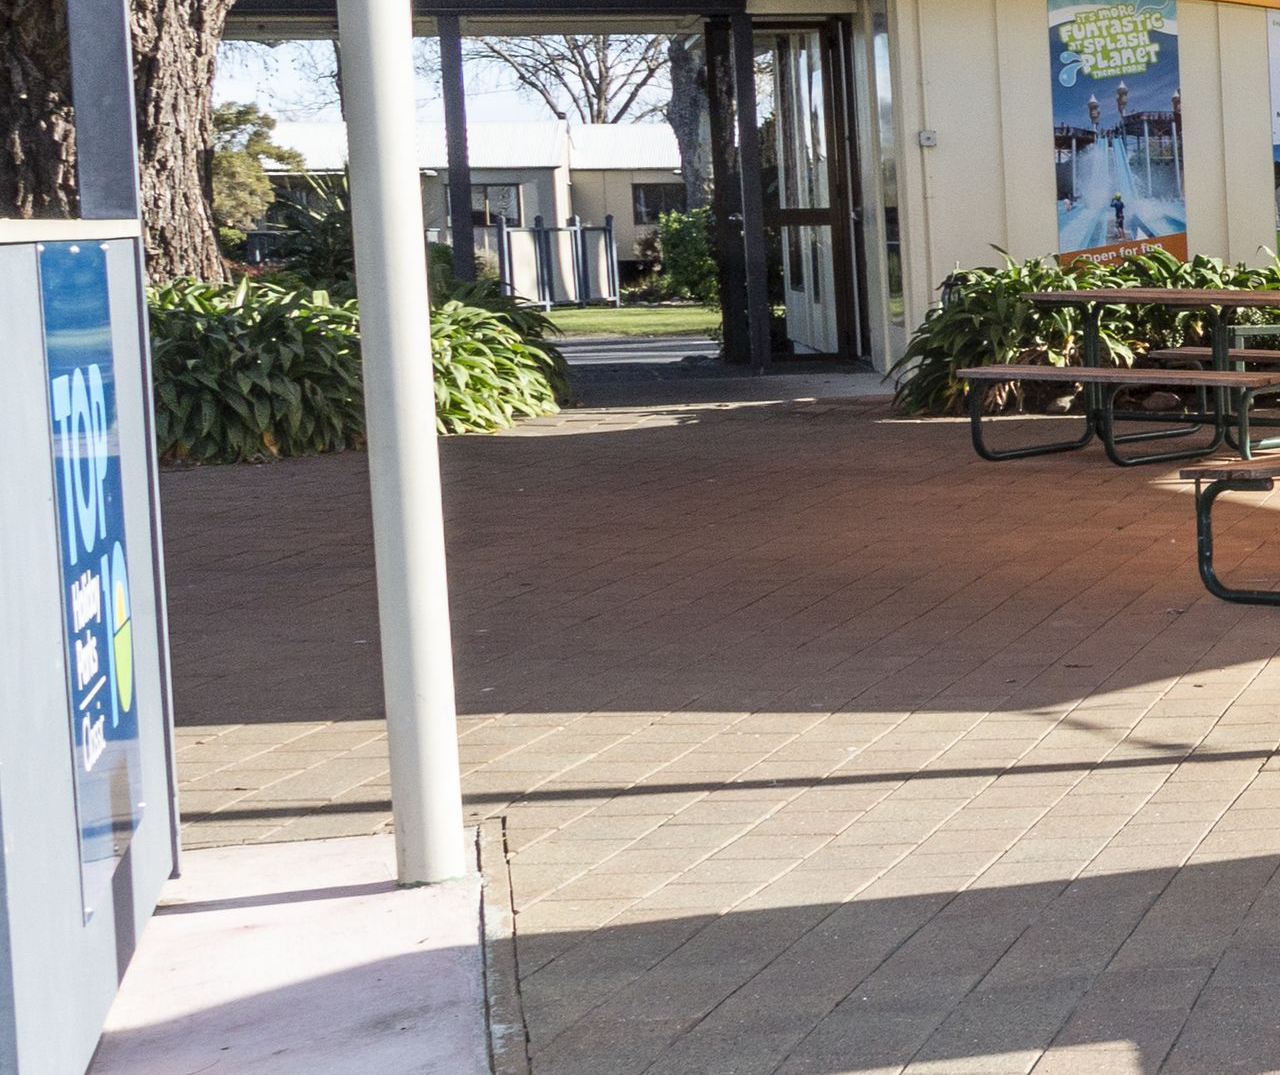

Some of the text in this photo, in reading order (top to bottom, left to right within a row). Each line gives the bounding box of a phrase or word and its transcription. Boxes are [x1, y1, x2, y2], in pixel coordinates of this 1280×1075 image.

[1120, 246, 1138, 258] for
[52, 363, 108, 566] TOP
[71, 568, 101, 634] Holiday
[75, 629, 99, 691] Parks
[101, 540, 132, 729] 10
